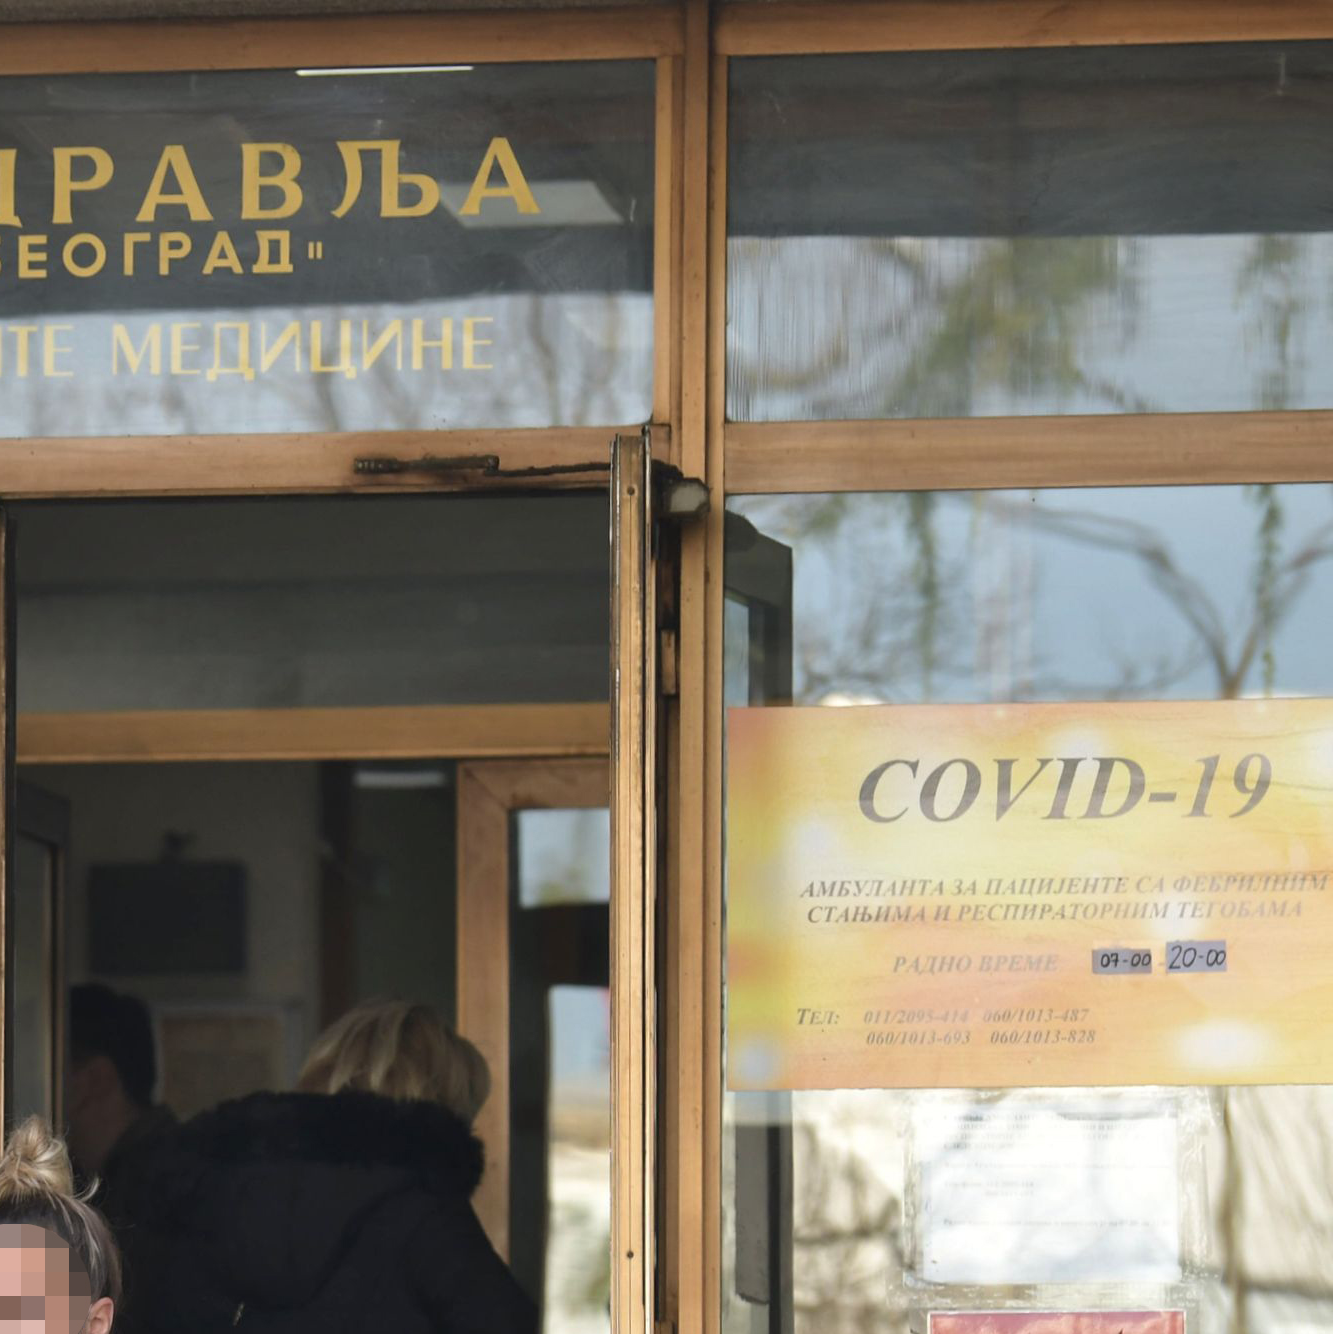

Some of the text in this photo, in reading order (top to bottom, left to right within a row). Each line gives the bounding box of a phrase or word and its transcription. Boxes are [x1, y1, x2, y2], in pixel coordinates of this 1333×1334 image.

[110, 316, 495, 381] МЕДИЦИНЕ
[858, 753, 1272, 824] COVID-19
[799, 873, 1328, 899] АМБУЛАНТА ЗА ПАЦИЈЕНТЕ СА ФЕБРИЛНИМ
[806, 899, 1303, 925] СТАЊИМА И РЕСПИРАТОРНИМ ТЕГОБАМА
[892, 953, 1059, 976] РАДНО ВРЕМЕ
[1100, 944, 1227, 970] 07-00 20-00
[866, 1030, 1096, 1046] 060/1013-693 060/1013-828
